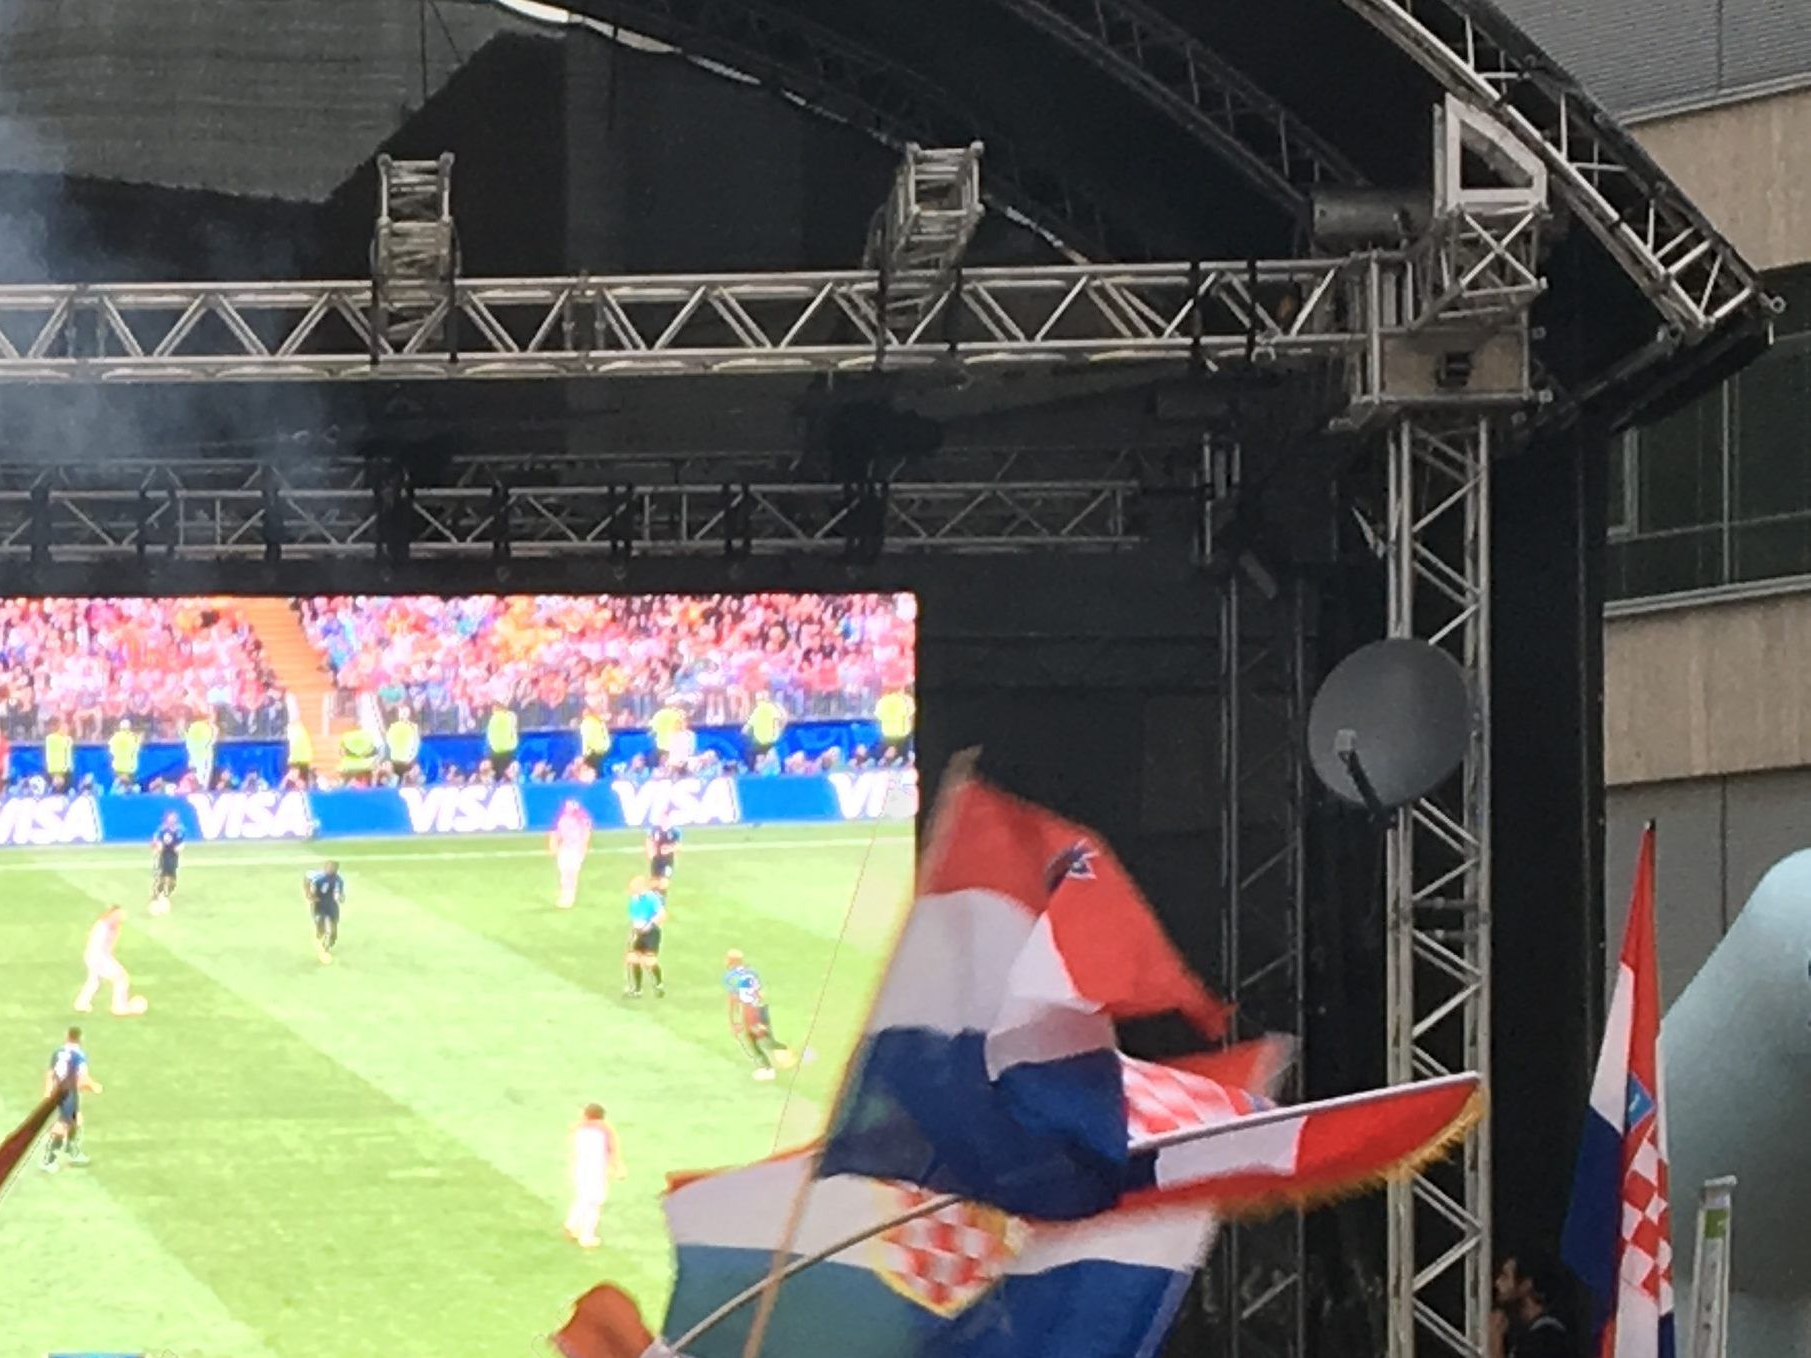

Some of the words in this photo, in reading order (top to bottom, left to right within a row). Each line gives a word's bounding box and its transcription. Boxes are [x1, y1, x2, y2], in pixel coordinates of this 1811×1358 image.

[189, 791, 315, 839] VISA
[399, 784, 526, 833] VISA
[612, 777, 739, 825] VISA
